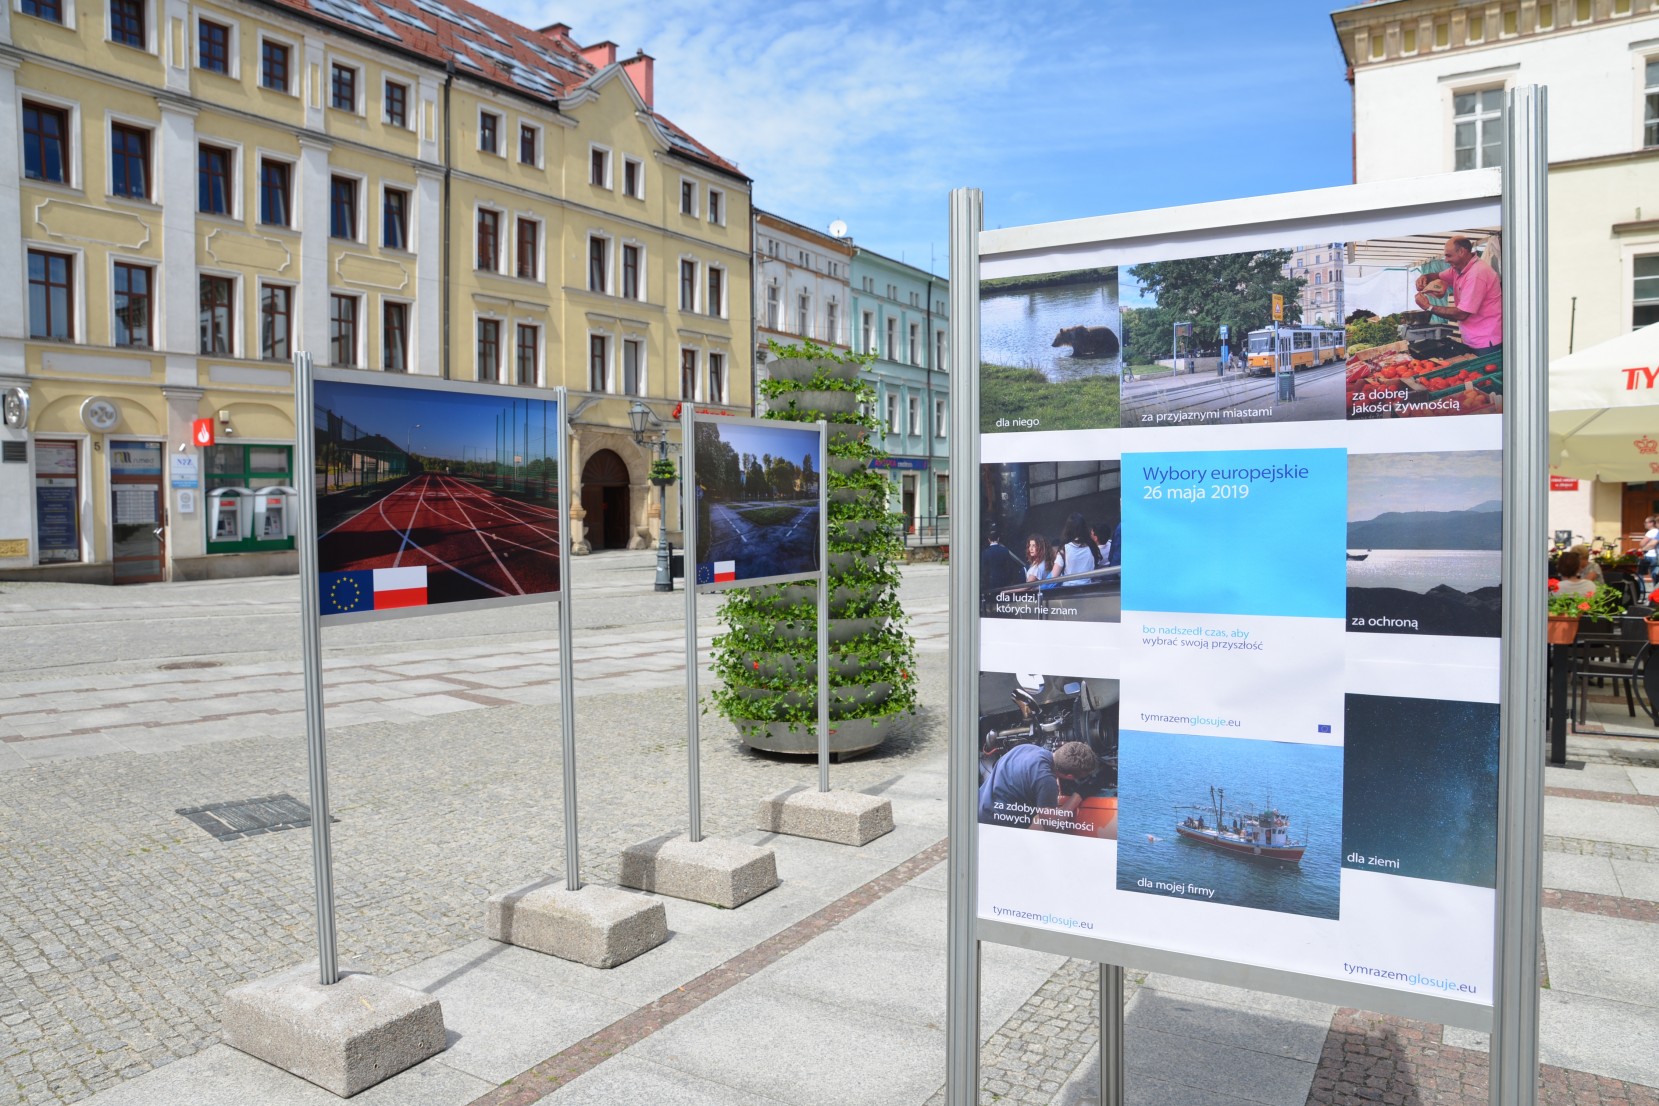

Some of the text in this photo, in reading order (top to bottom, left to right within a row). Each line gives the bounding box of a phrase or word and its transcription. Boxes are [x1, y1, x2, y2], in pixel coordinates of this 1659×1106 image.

[1352, 388, 1408, 401] za dobrej
[1141, 406, 1273, 424] za przyjaznymi miastami
[1351, 399, 1460, 415] jakości żywnością
[995, 417, 1040, 429] dla niego
[94, 442, 101, 451] 5
[1142, 463, 1310, 484] Wybory europejskie
[1143, 484, 1249, 502] 26 maja 2019
[996, 593, 1038, 604] dla ludzi,
[996, 604, 1078, 615] których nie znam
[1352, 615, 1419, 631] za ochroną
[1142, 625, 1249, 640] bo nadszedł czas, aby
[1142, 636, 1263, 651] wybrać swoją przyszłość
[1140, 712, 1241, 727] tymrazemglosuje.eu
[993, 801, 1074, 818] za zdobywaniem
[993, 812, 1094, 832] nowych umiejętności
[1346, 852, 1400, 869] dla ziemi
[1137, 877, 1215, 898] dla mojej firmy
[992, 905, 1094, 930] tymrazemglosuje.eu
[1343, 962, 1477, 994] tymrazemglosuje.eu
